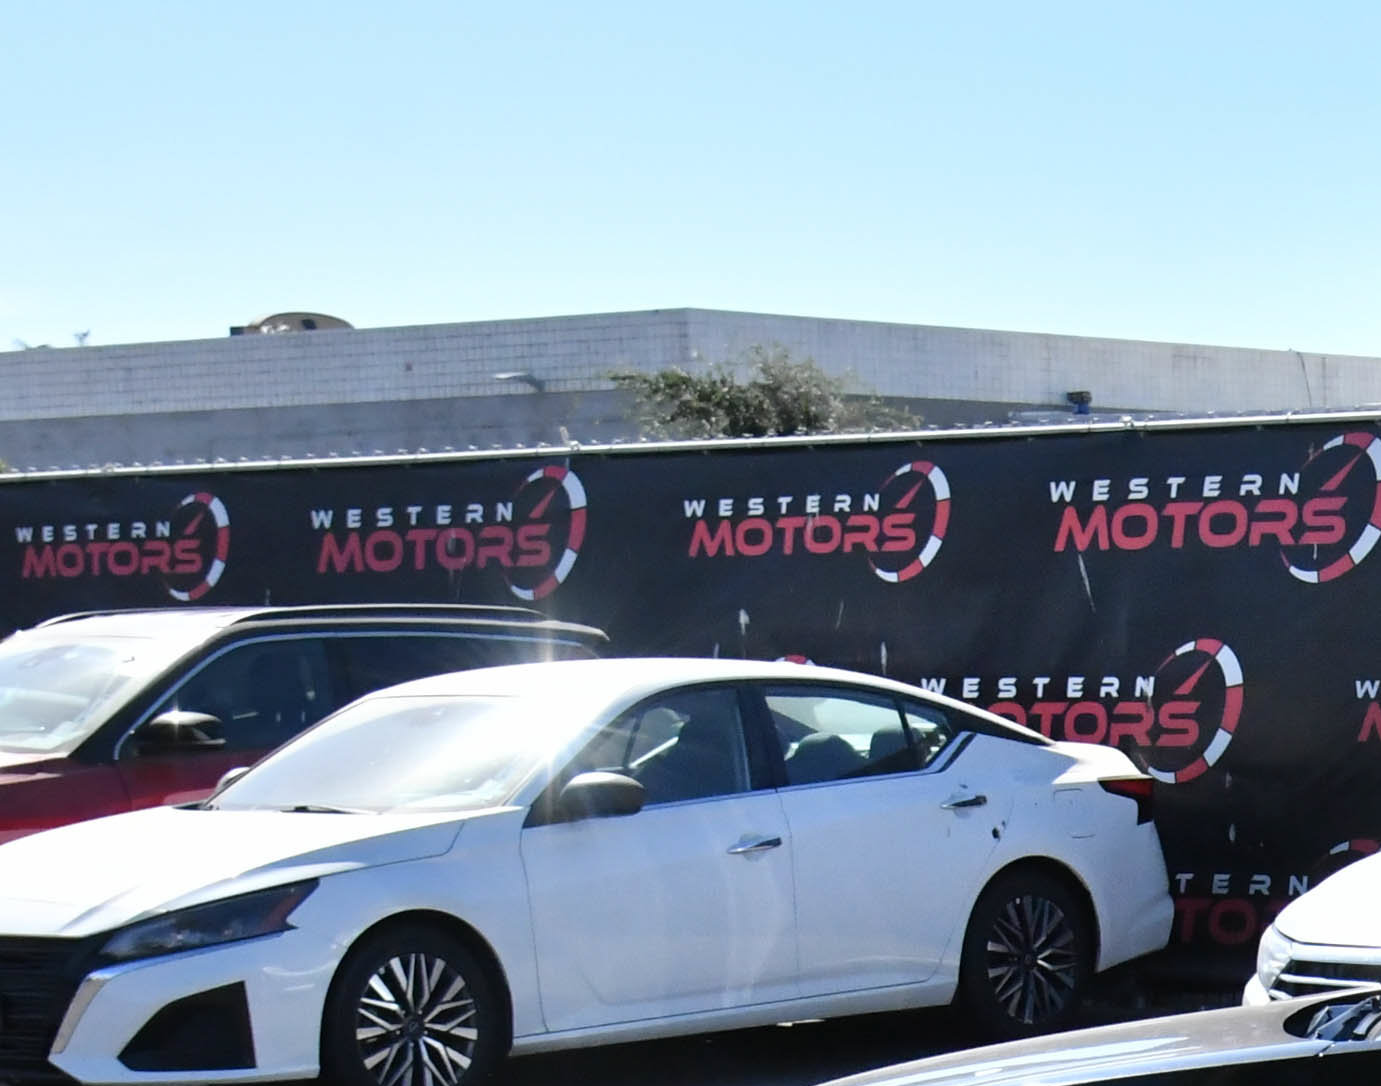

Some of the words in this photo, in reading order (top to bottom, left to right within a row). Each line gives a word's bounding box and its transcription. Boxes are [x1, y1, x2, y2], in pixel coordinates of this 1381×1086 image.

[1049, 472, 1300, 503] WESTERN
[311, 502, 513, 529] WESTERN
[683, 493, 880, 521] WESTERN
[17, 521, 170, 540] WESTERN
[689, 512, 916, 557] MOTORS
[1054, 495, 1347, 553] MOTORS
[23, 539, 202, 577] MOTORS
[318, 524, 550, 572] MOTORS
[919, 675, 1155, 699] WESTERN
[987, 700, 1201, 747] TORS
[1175, 873, 1309, 896] TERN
